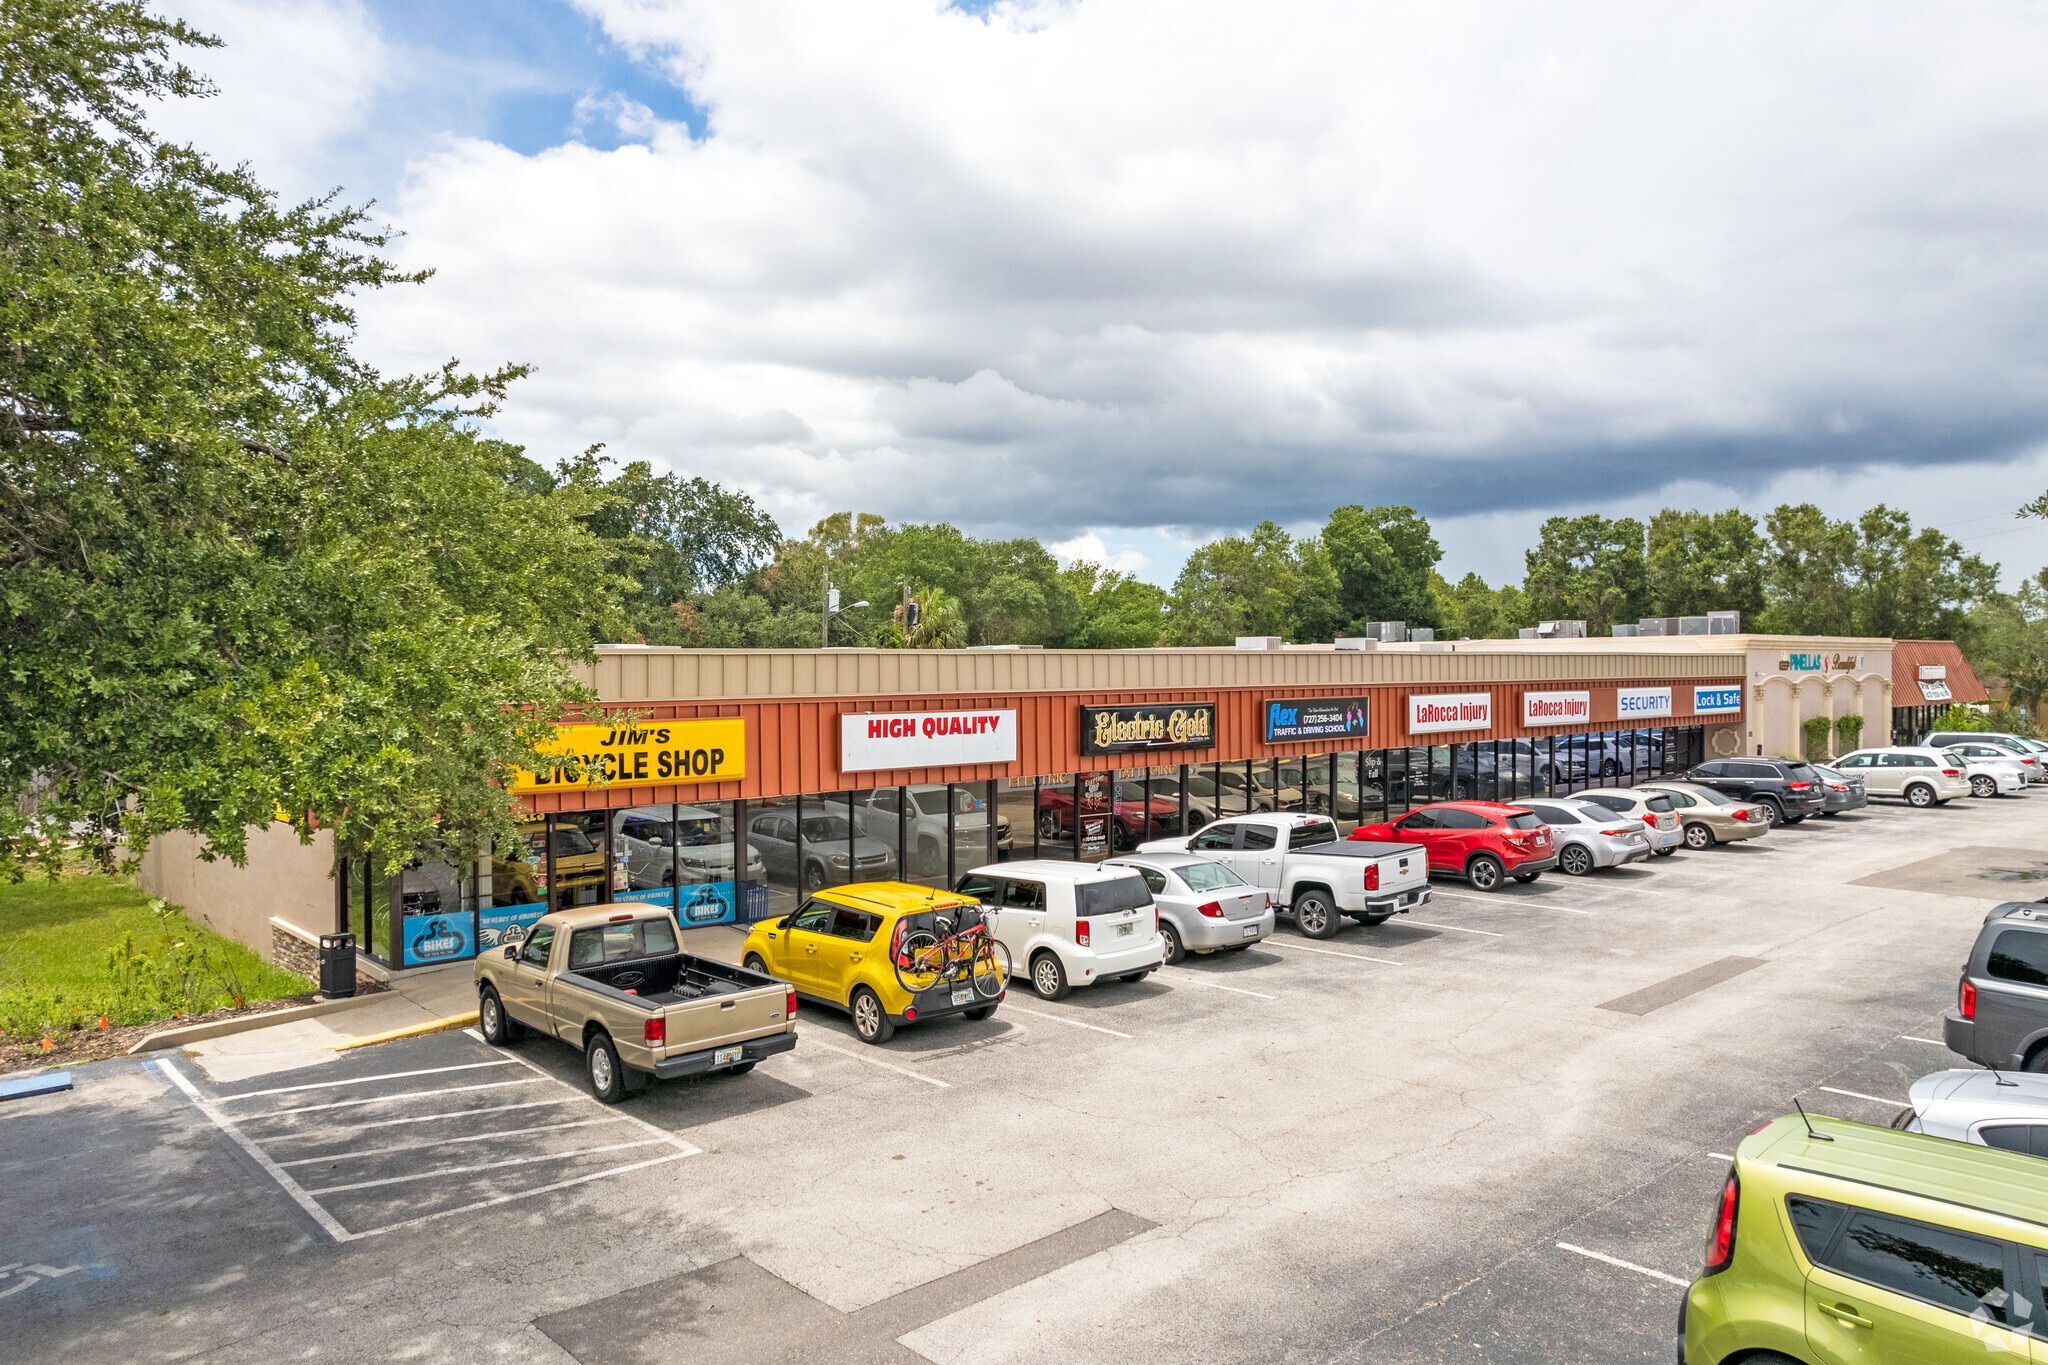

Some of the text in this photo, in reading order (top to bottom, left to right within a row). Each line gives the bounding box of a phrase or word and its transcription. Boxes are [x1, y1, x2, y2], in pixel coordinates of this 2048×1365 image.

[1529, 698, 1588, 717] LaRocca Injury
[1621, 695, 1670, 711] SECURITY
[1696, 693, 1740, 707] Lock & Safe
[1416, 702, 1488, 723] LaRocca Injury
[868, 715, 1000, 739] HIGH QUALITY
[1094, 708, 1211, 748] Electric Gold
[1268, 703, 1298, 740] flex
[600, 728, 671, 747] JIM'S
[1274, 724, 1346, 737] TRAFFIC & DRIVING SCHOOL
[657, 748, 725, 778] SHOP
[1365, 757, 1376, 768] Slip
[1368, 769, 1379, 779] Fall
[694, 903, 720, 916] BIKES
[423, 937, 454, 952] BIKES
